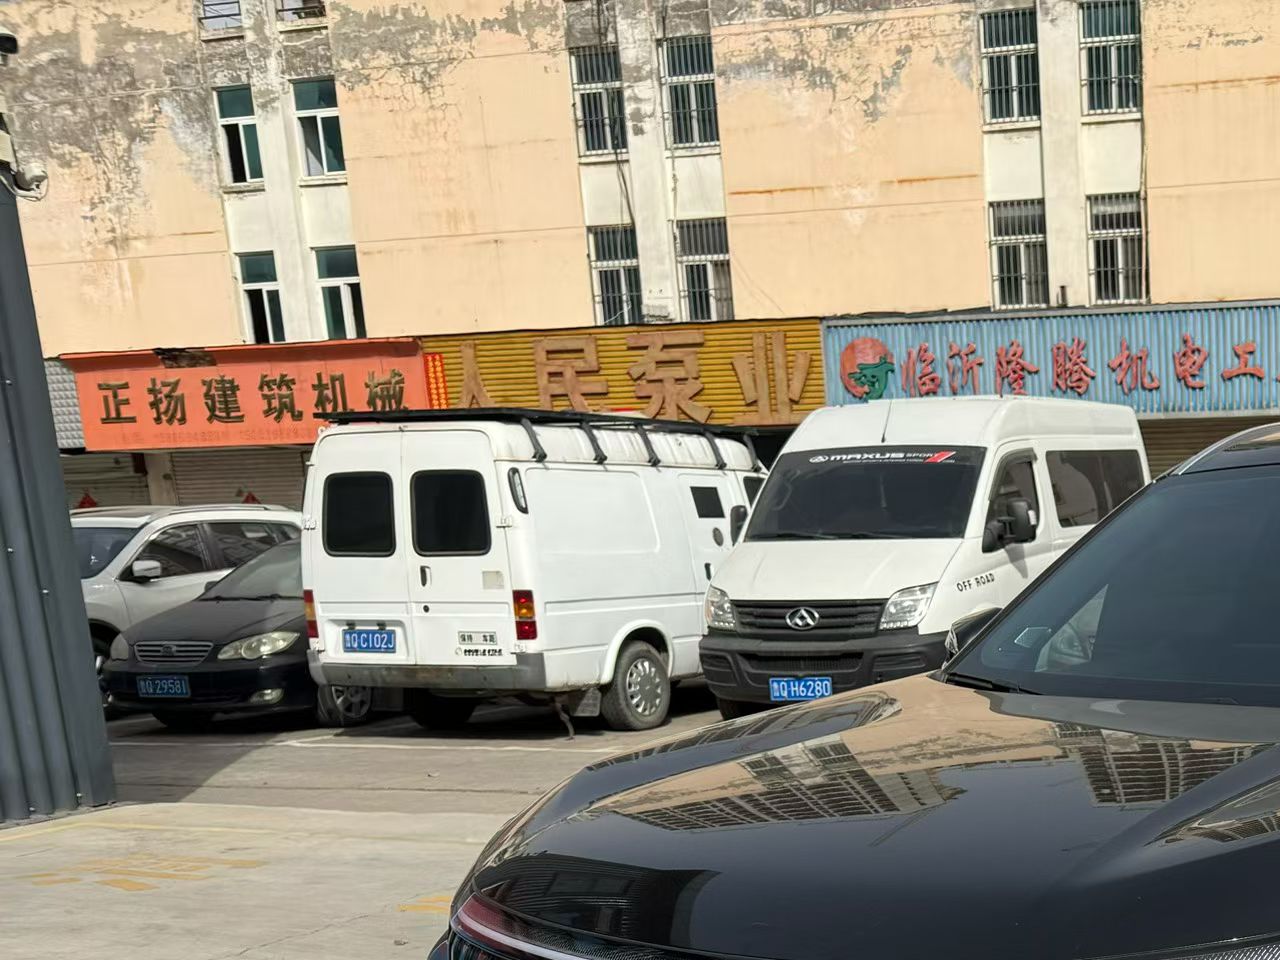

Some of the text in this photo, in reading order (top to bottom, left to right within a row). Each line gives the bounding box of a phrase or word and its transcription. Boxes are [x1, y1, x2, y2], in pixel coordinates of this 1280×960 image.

[97, 368, 410, 426] 正扬建筑机械
[830, 452, 905, 461] MAXUS
[956, 573, 995, 592] OFF ROAD
